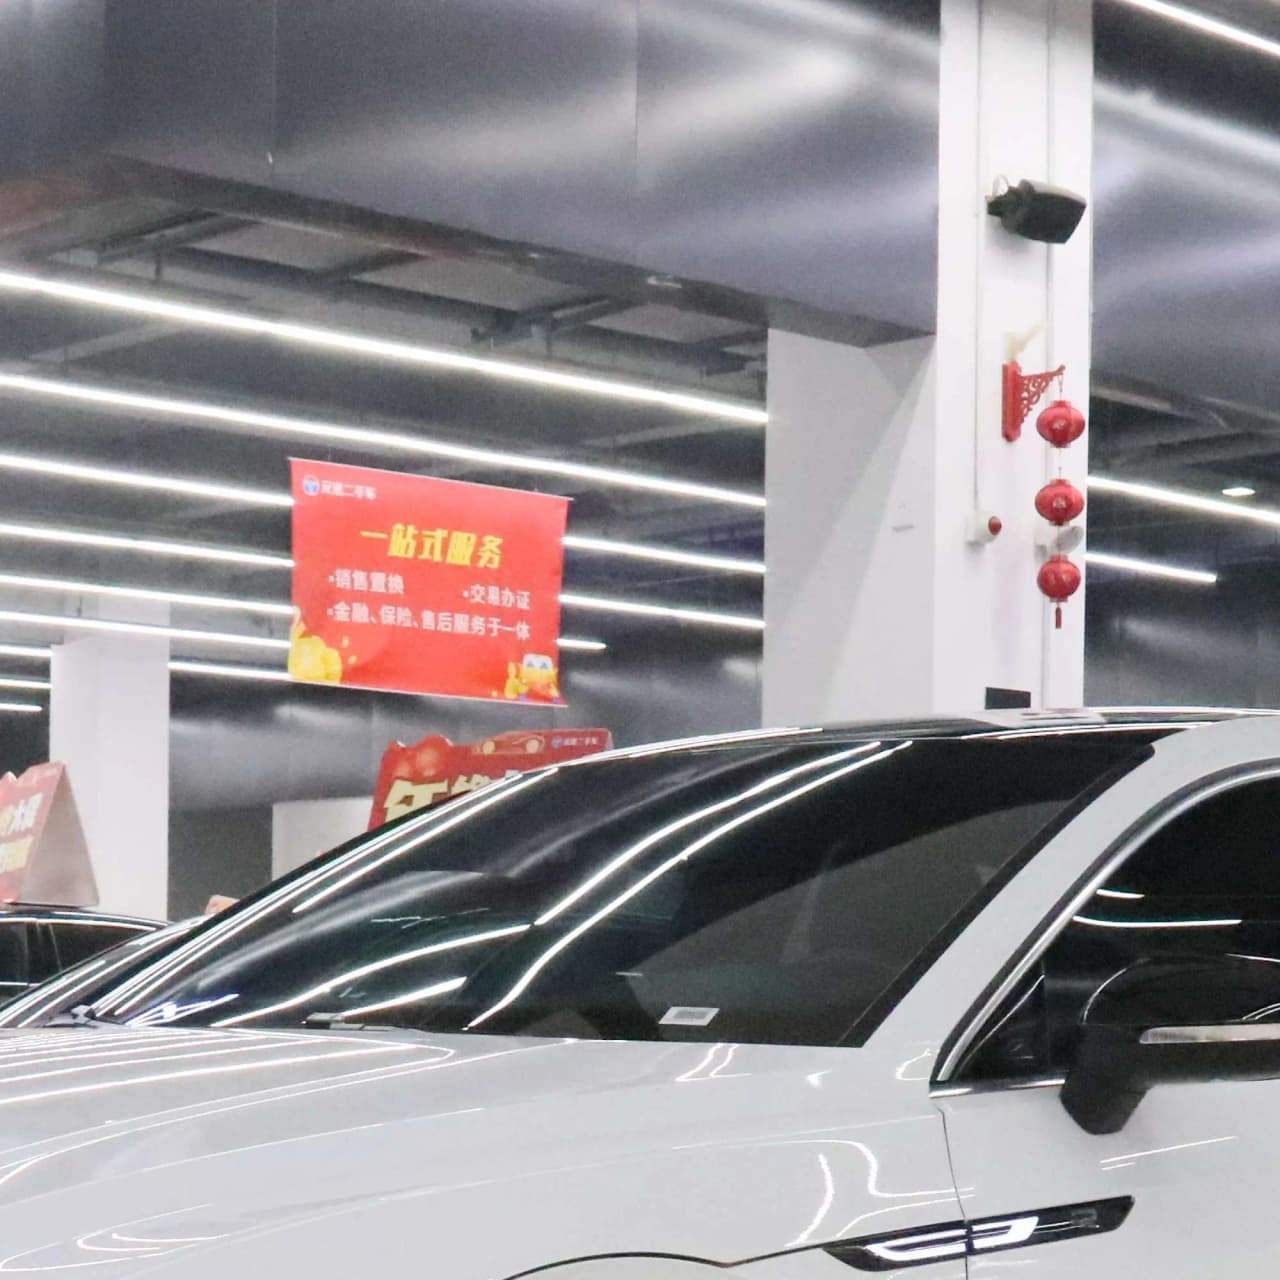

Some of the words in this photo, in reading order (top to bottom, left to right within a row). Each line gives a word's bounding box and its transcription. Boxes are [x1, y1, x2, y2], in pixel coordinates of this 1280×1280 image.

[360, 523, 504, 569] 一站式服务
[334, 567, 405, 595] 销售置换
[469, 582, 531, 611] 交易办证
